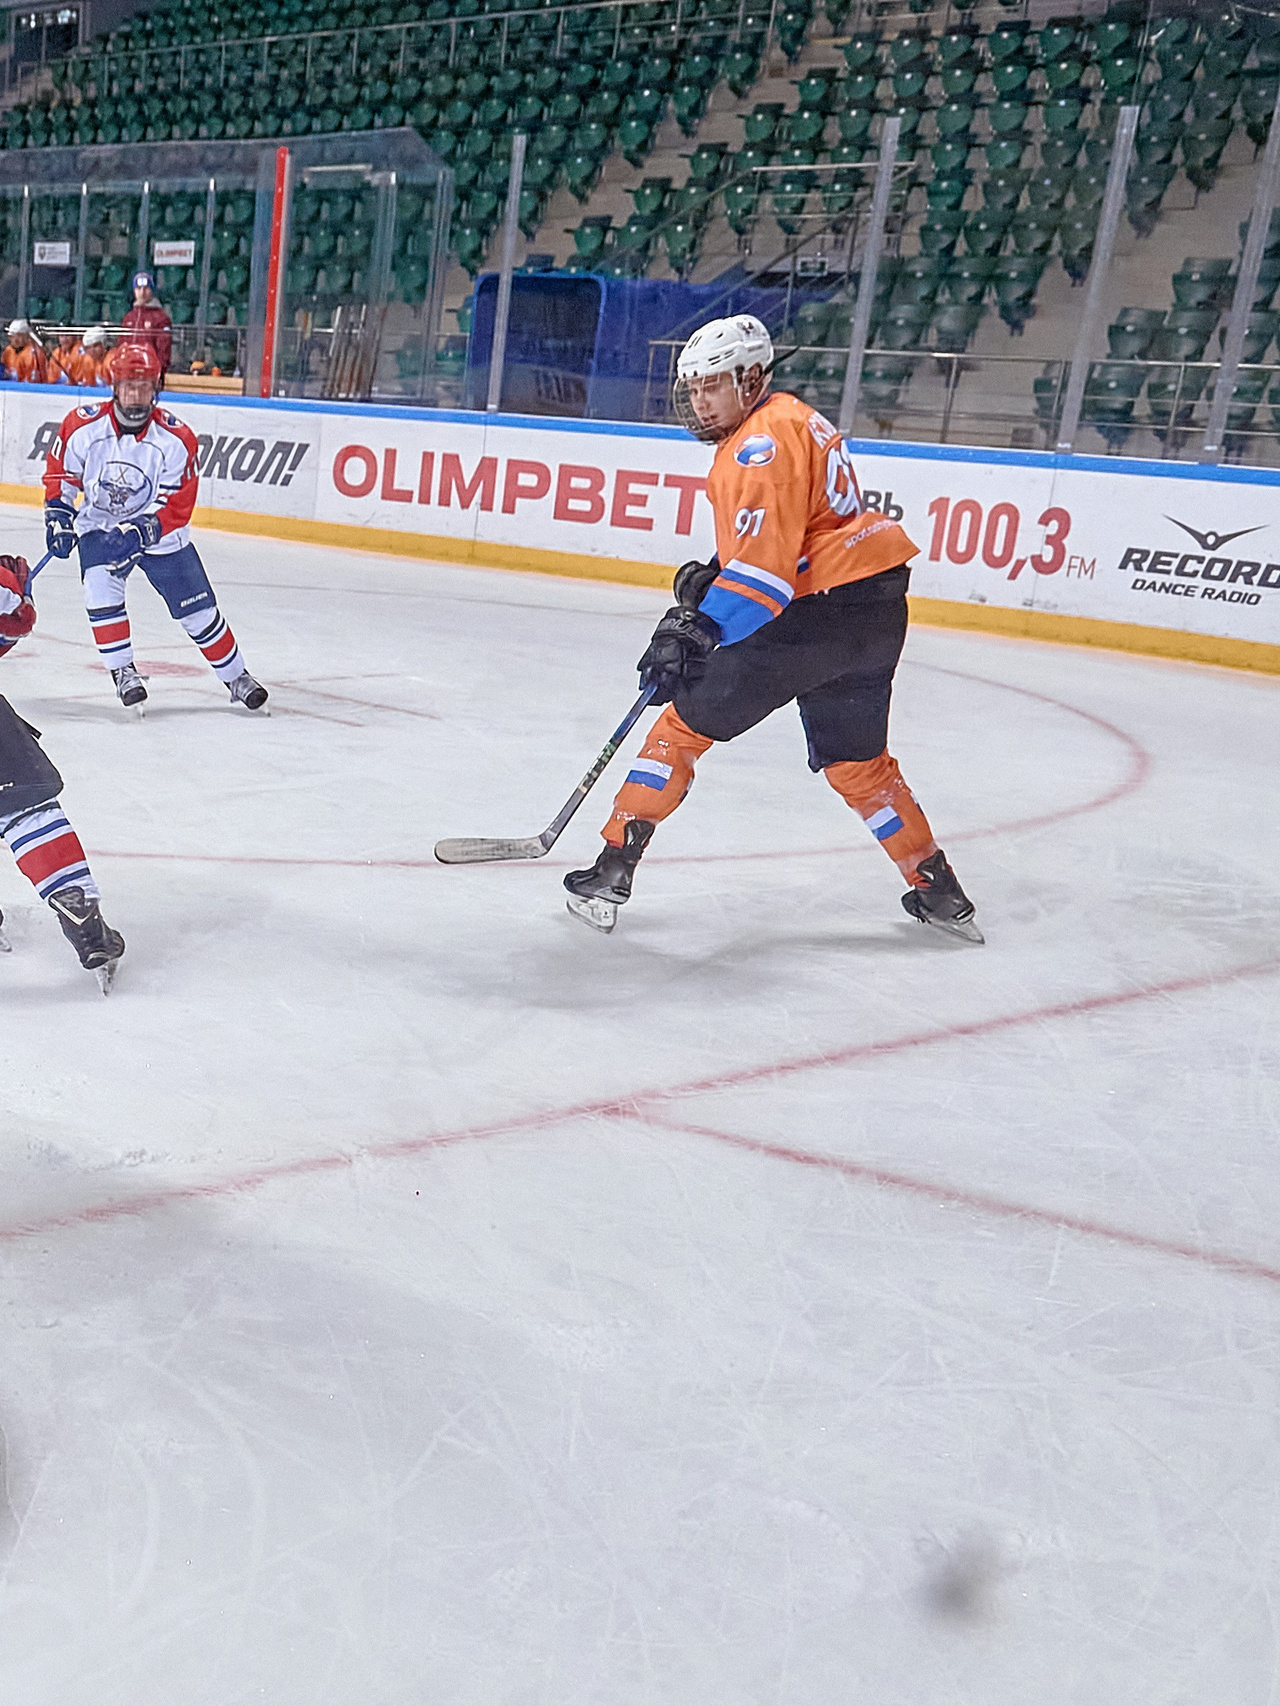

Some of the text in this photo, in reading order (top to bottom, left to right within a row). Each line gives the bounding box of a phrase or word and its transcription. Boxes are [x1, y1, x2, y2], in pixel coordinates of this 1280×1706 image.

[197, 433, 310, 487] ОКОЛ!
[332, 443, 710, 536] OLIMPBET
[734, 507, 766, 539] 91
[928, 496, 1072, 581] 100,3
[1066, 555, 1097, 581] FM
[1118, 547, 1280, 589] RECORD
[1131, 578, 1262, 606] DANCE RADIO
